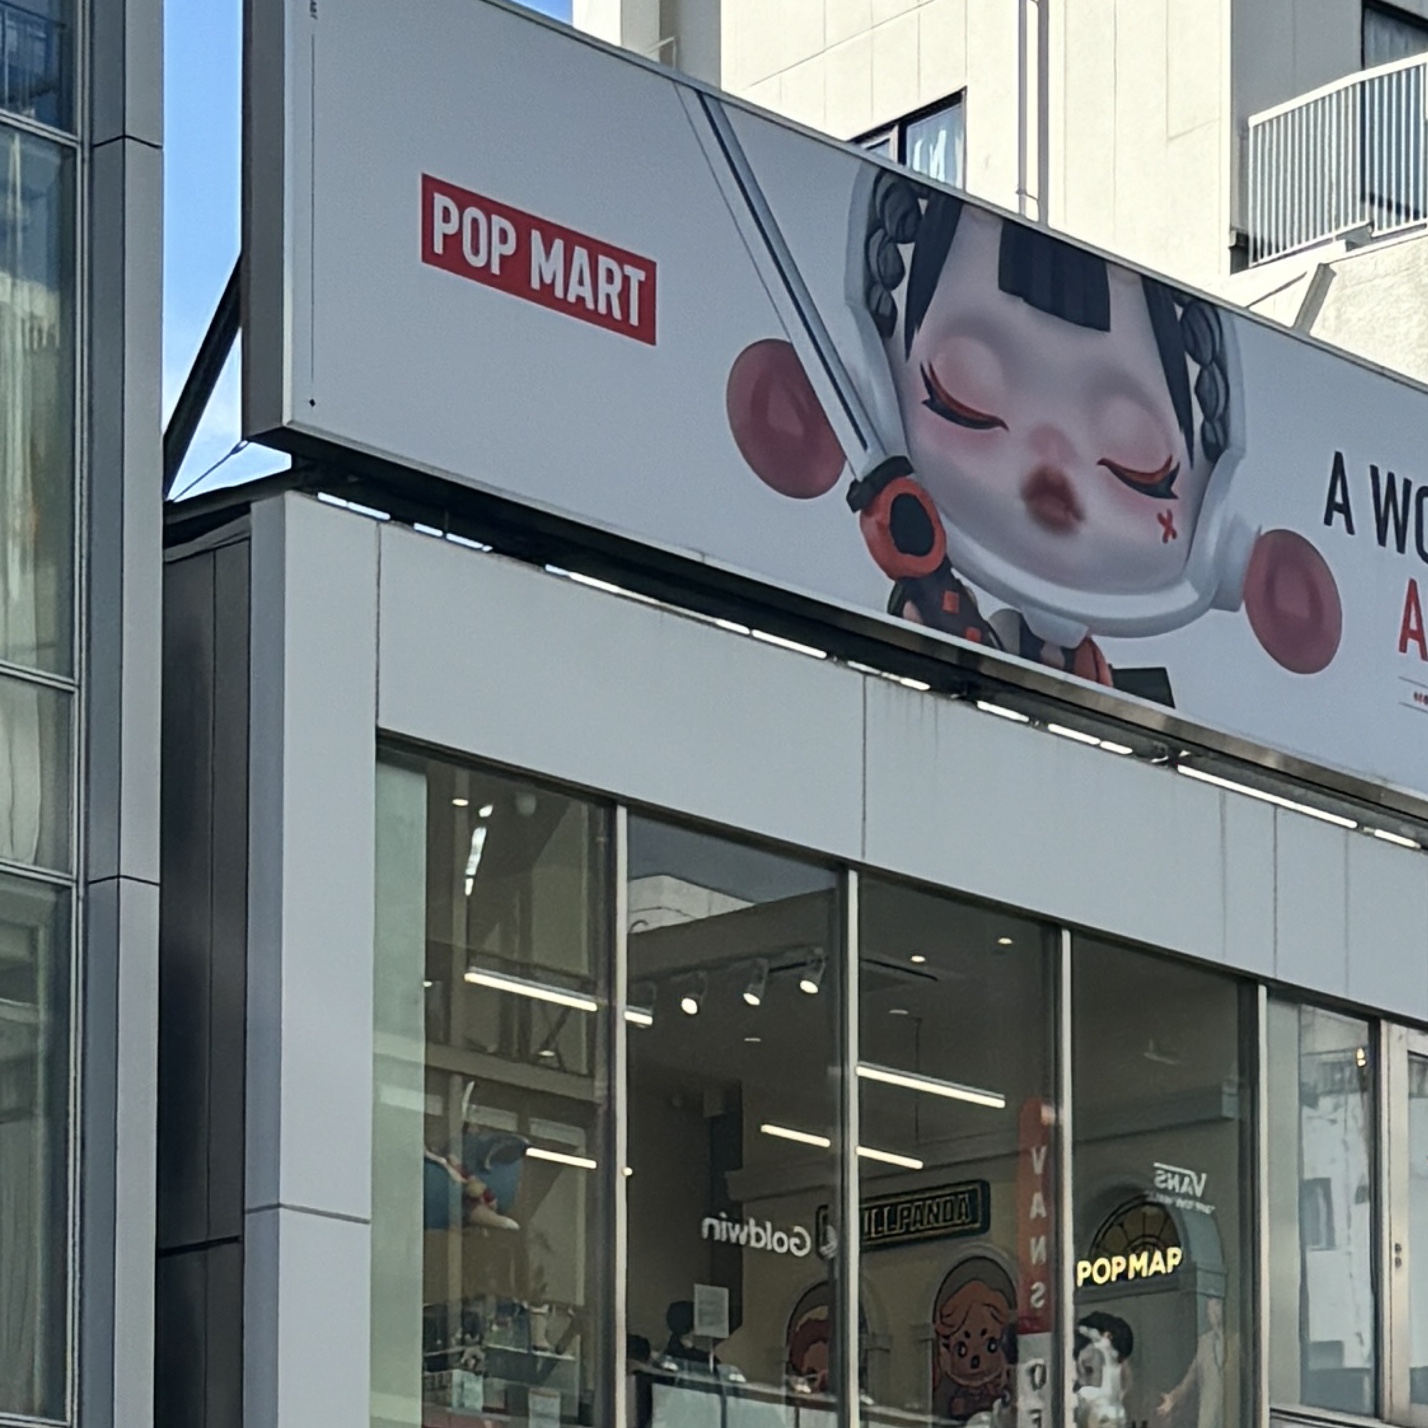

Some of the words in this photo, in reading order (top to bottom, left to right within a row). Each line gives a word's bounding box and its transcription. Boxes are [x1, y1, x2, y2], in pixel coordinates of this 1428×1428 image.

[433, 191, 517, 277] POP
[529, 228, 646, 327] MART
[1323, 450, 1355, 536] A
